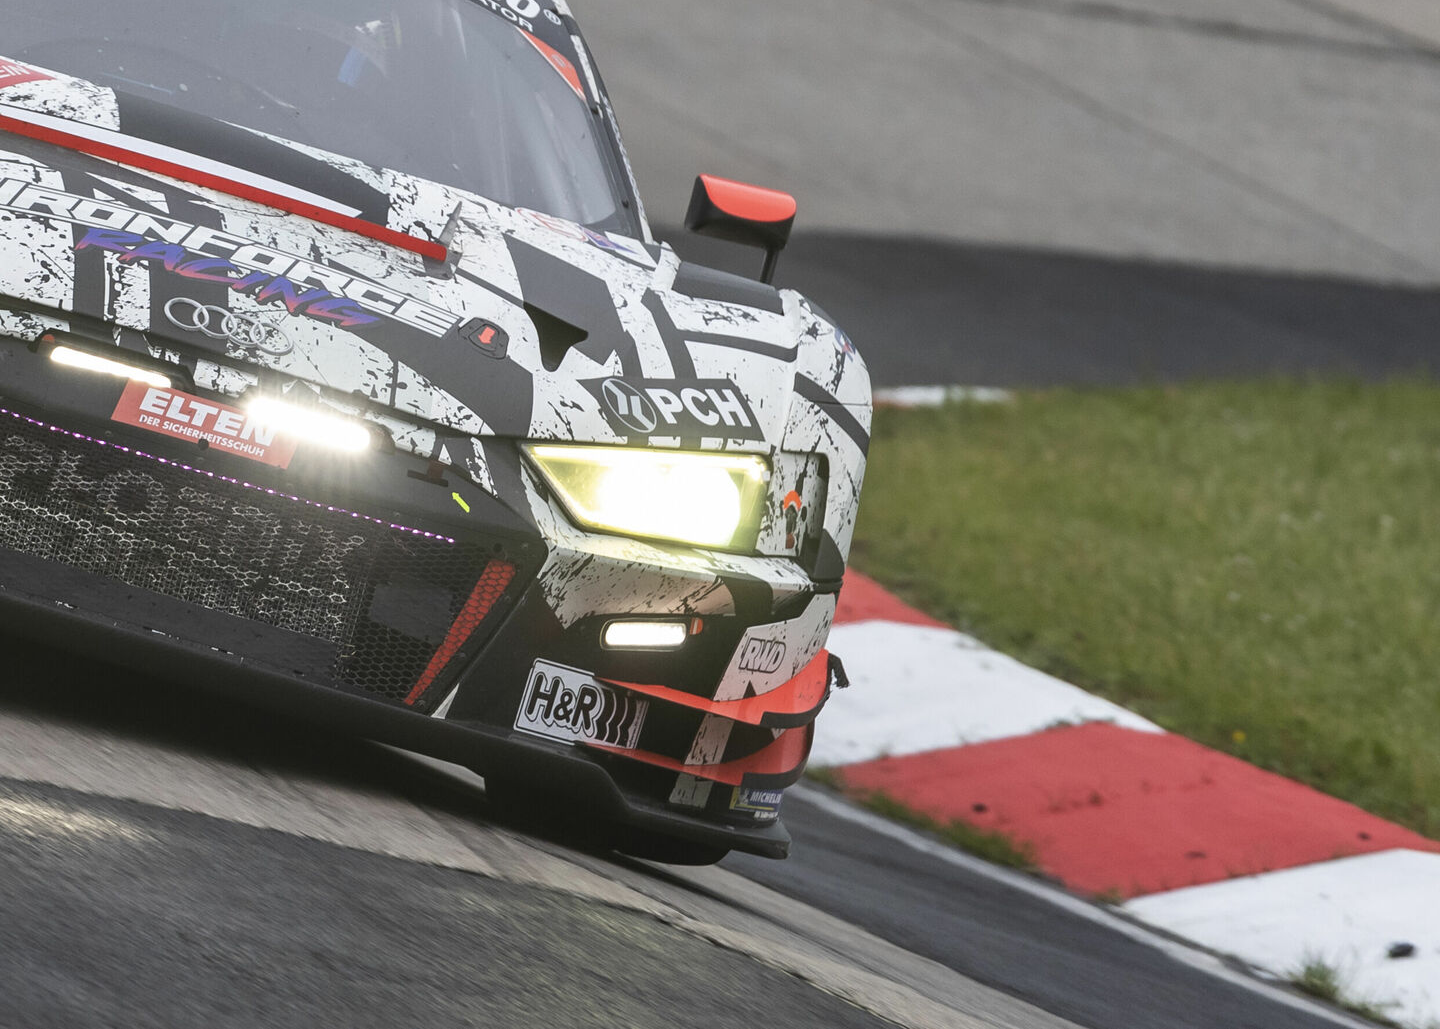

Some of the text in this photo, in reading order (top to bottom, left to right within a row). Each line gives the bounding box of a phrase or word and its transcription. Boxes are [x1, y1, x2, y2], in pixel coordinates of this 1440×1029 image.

[74, 227, 382, 327] RACING
[139, 387, 278, 447] ELTEN
[644, 387, 753, 428] PCH
[139, 413, 265, 458] DER SICHERHEITSSCHUH
[739, 637, 787, 674] RWD
[526, 672, 600, 734] H&R
